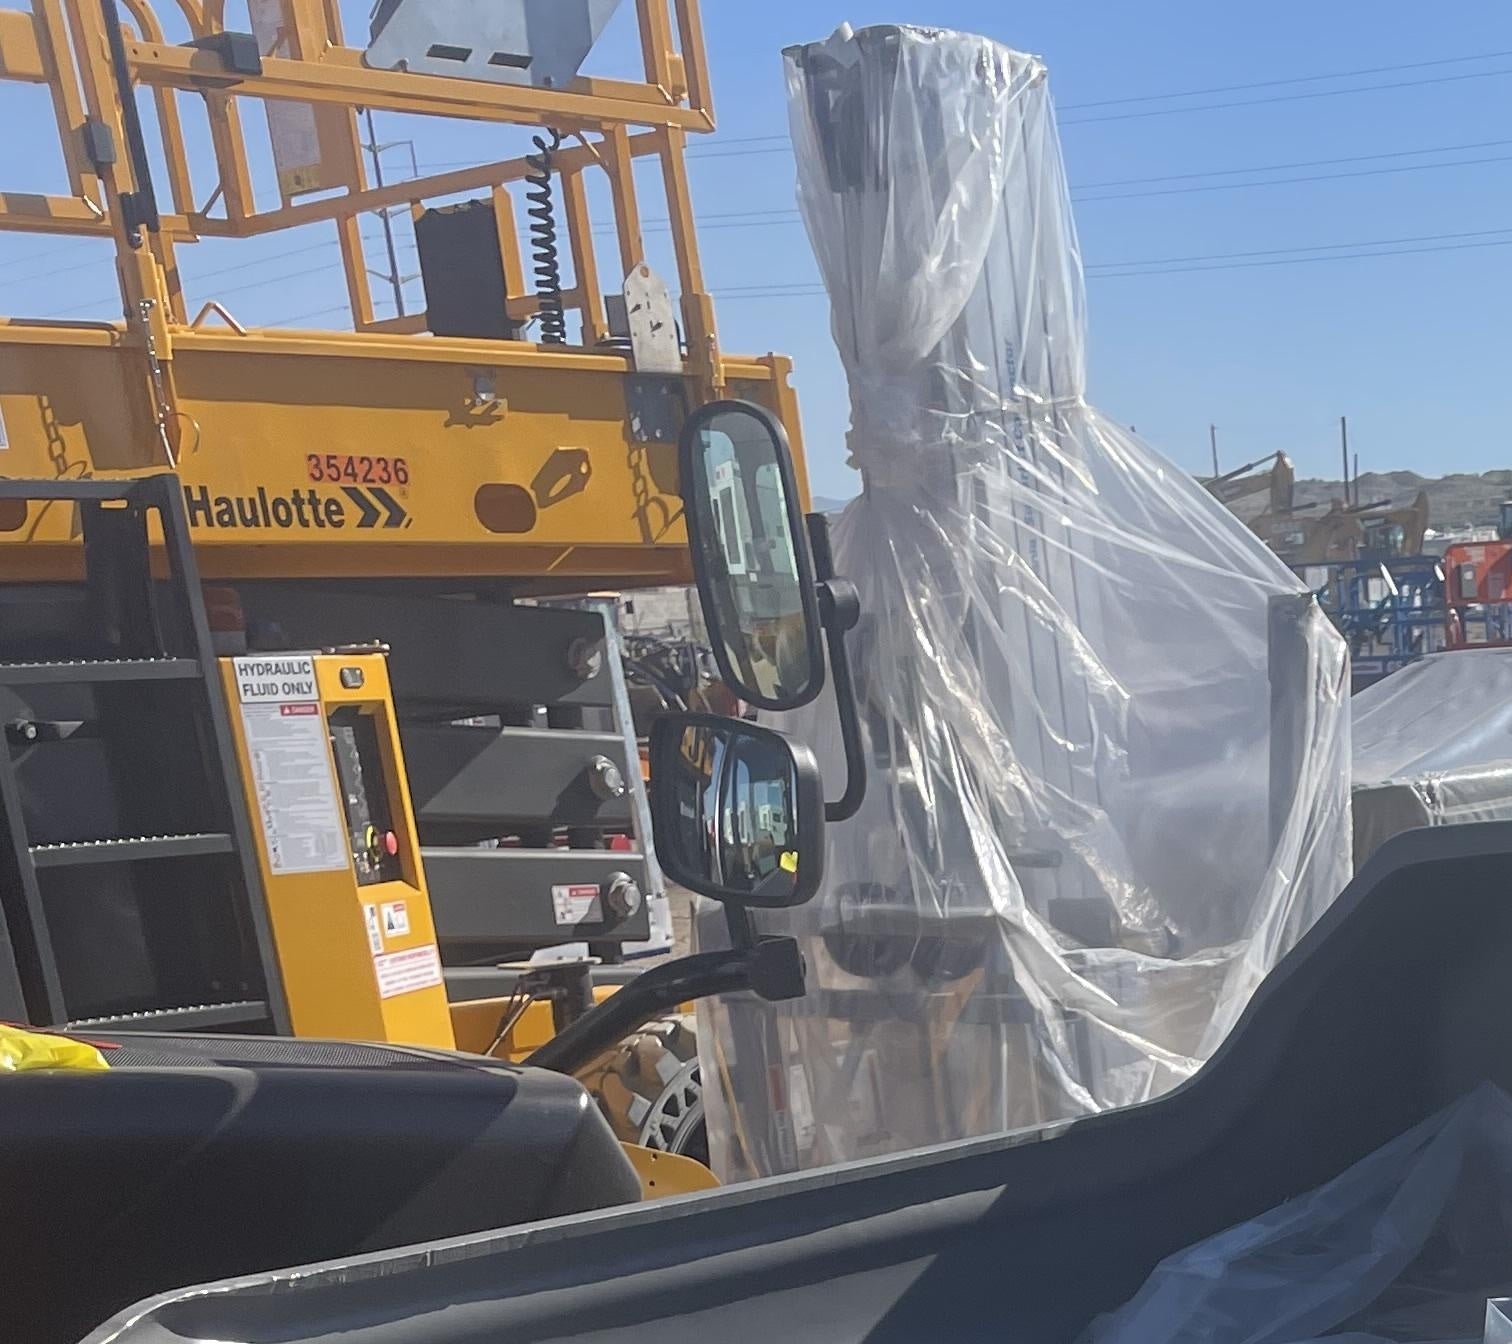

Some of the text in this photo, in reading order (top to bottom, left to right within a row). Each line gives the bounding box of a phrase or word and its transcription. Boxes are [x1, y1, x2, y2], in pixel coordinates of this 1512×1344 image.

[307, 453, 409, 485] 354236
[183, 485, 345, 529] Haulotte
[238, 661, 311, 677] HYDRAULIC
[242, 681, 313, 697] FLUID ONLY
